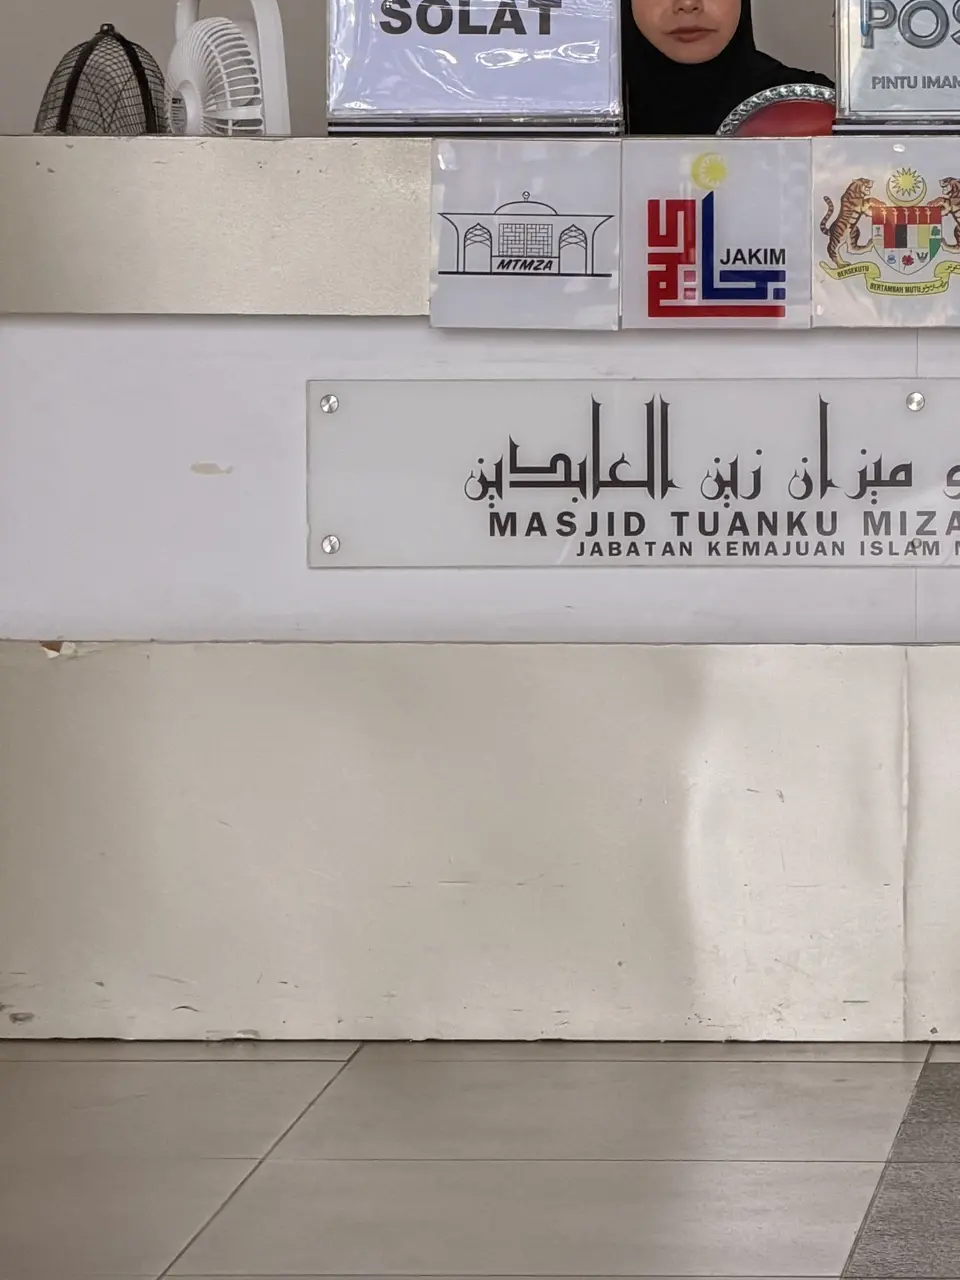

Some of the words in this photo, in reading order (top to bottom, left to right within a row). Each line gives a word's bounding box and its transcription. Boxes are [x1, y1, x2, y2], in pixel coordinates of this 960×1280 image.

[872, 76, 918, 90] PINTU
[720, 248, 786, 265] JAKIM
[497, 259, 553, 271] MTMZA
[837, 265, 870, 278] BERSEKUTU
[870, 282, 904, 293] BERTAMBAH
[489, 511, 646, 537] MASJID
[671, 511, 838, 536] TUANKU
[576, 541, 692, 557] JABATAN
[708, 541, 845, 556] KEMAJUAN
[860, 540, 940, 556] ISLAM
